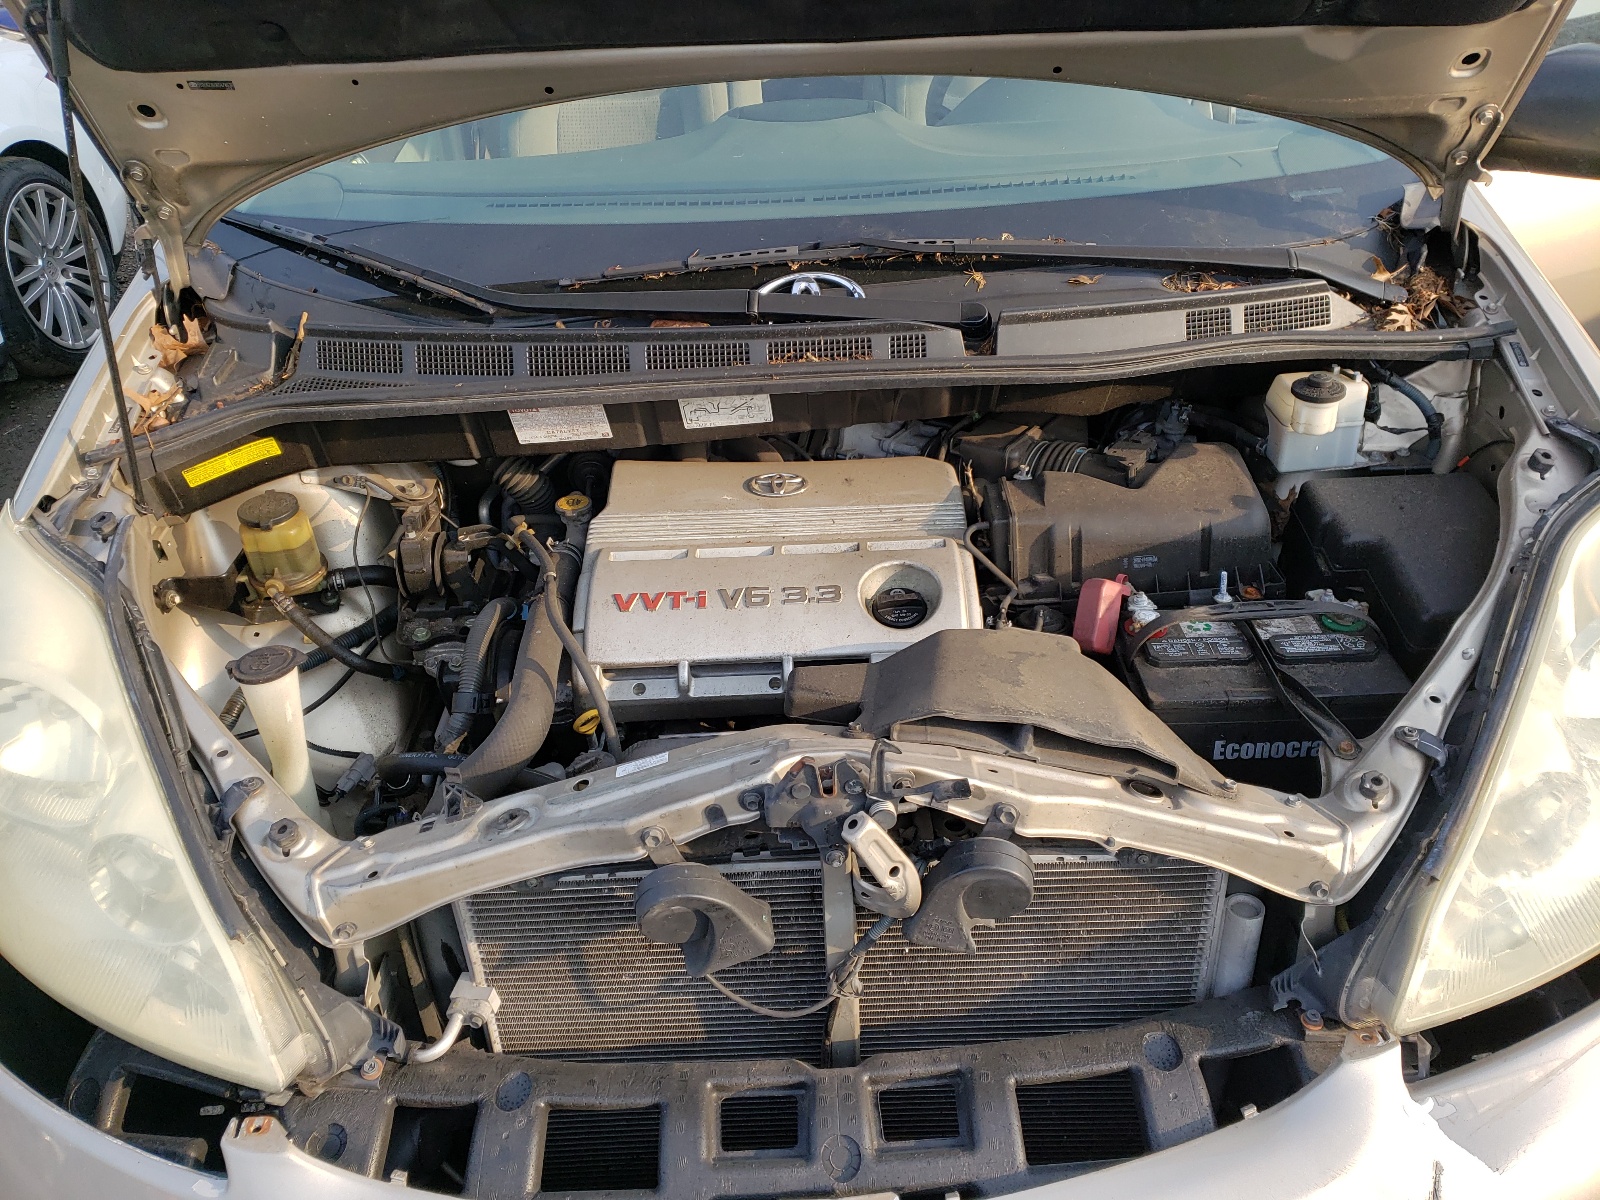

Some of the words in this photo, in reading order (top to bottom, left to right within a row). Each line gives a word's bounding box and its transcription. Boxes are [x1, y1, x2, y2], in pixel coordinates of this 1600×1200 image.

[613, 590, 708, 612] VVT-i
[717, 586, 772, 609] V6
[781, 584, 843, 605] 3.3
